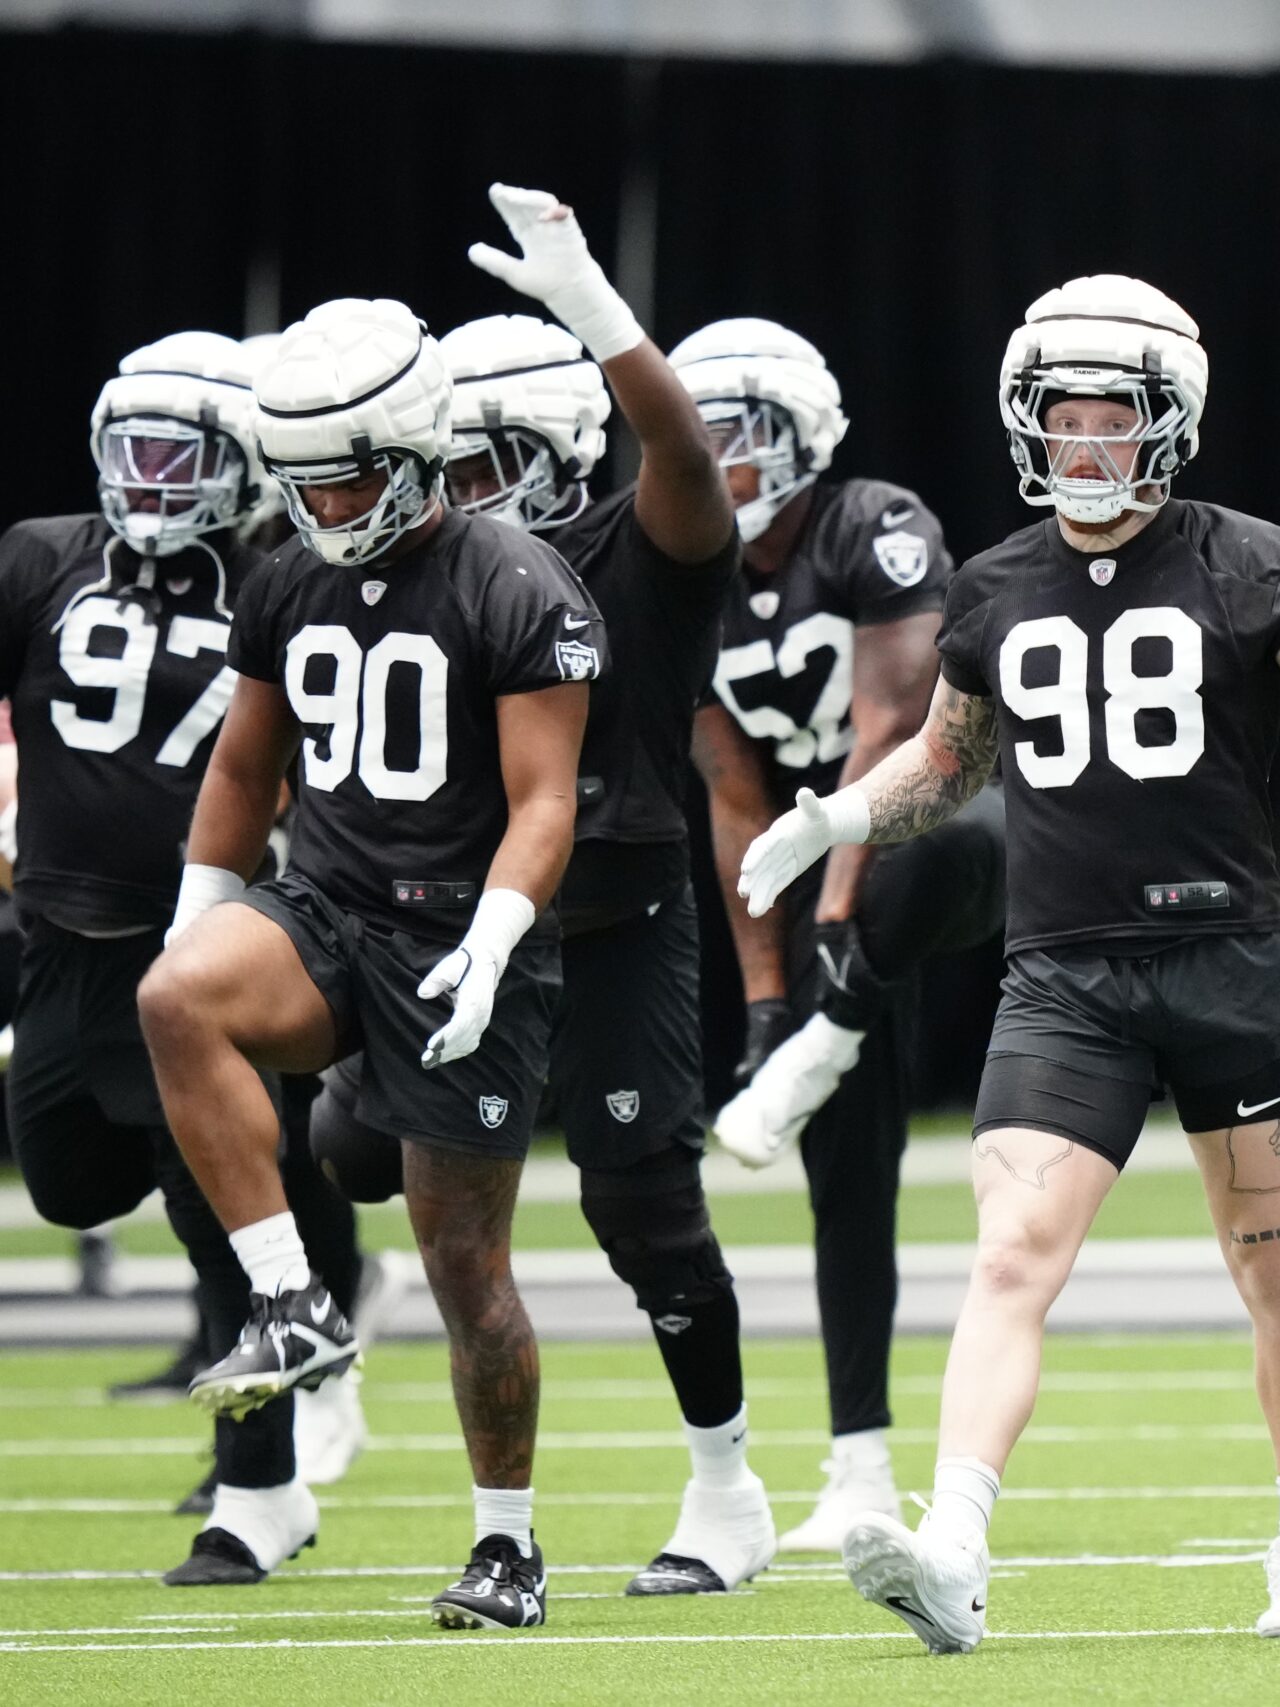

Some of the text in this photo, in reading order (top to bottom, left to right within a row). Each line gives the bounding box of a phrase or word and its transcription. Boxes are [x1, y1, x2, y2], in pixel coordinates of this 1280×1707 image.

[50, 597, 240, 768] 97
[285, 624, 449, 802] 90
[712, 612, 856, 769] 52
[999, 606, 1205, 789] 98
